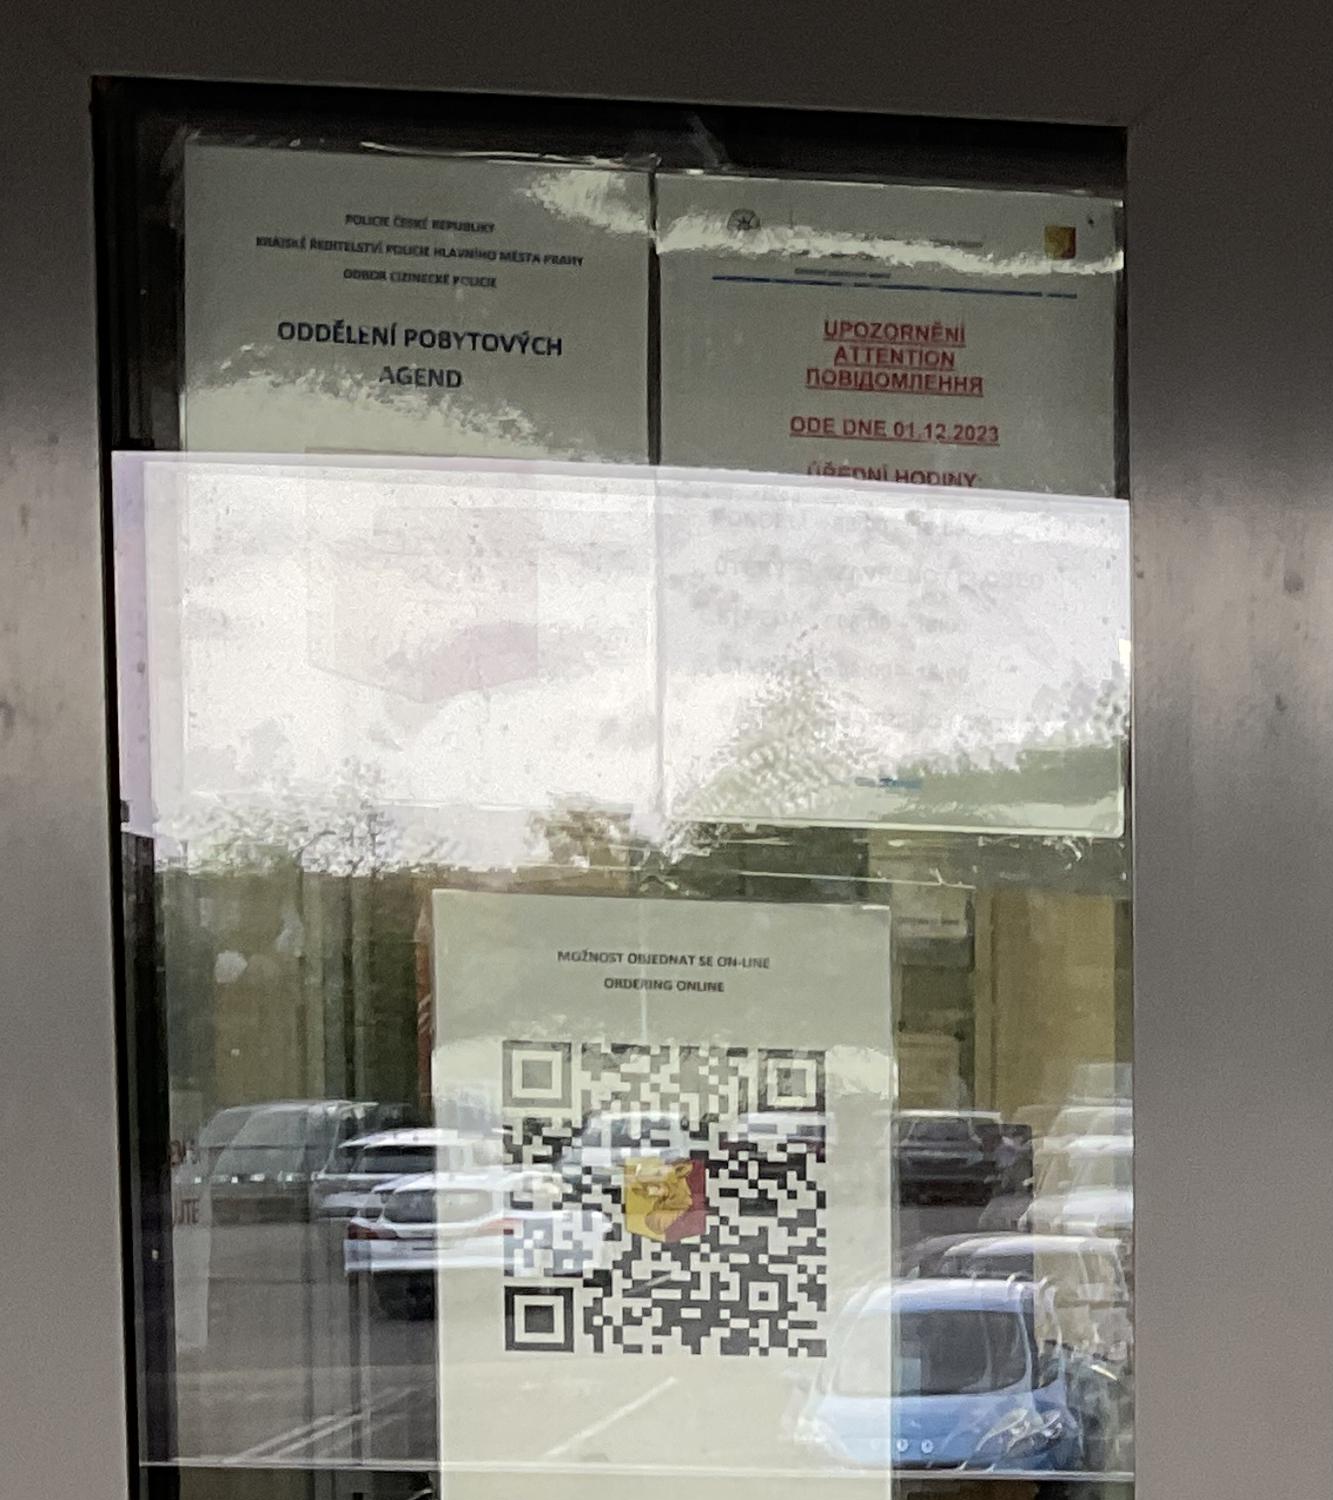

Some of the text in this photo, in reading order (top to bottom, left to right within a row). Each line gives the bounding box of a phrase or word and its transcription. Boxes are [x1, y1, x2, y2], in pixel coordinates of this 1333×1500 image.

[345, 214, 495, 233] POLICIE ČESKÉ REPUBLIKY
[277, 319, 562, 356] ODDĚLENÍ POBYTOVÝCH
[823, 319, 966, 343] UPOZORNĚNÍ
[834, 346, 955, 366] ATTENTION
[379, 365, 463, 388] AGEND
[807, 367, 983, 394] ПОВІДОМЛЕННЯ
[790, 415, 999, 443] ODE DNE 01.12.2023
[557, 948, 770, 970] MOŽNOST OBJEDNAT SE ON-LINE
[603, 977, 724, 993] ORDERING ONLINE
